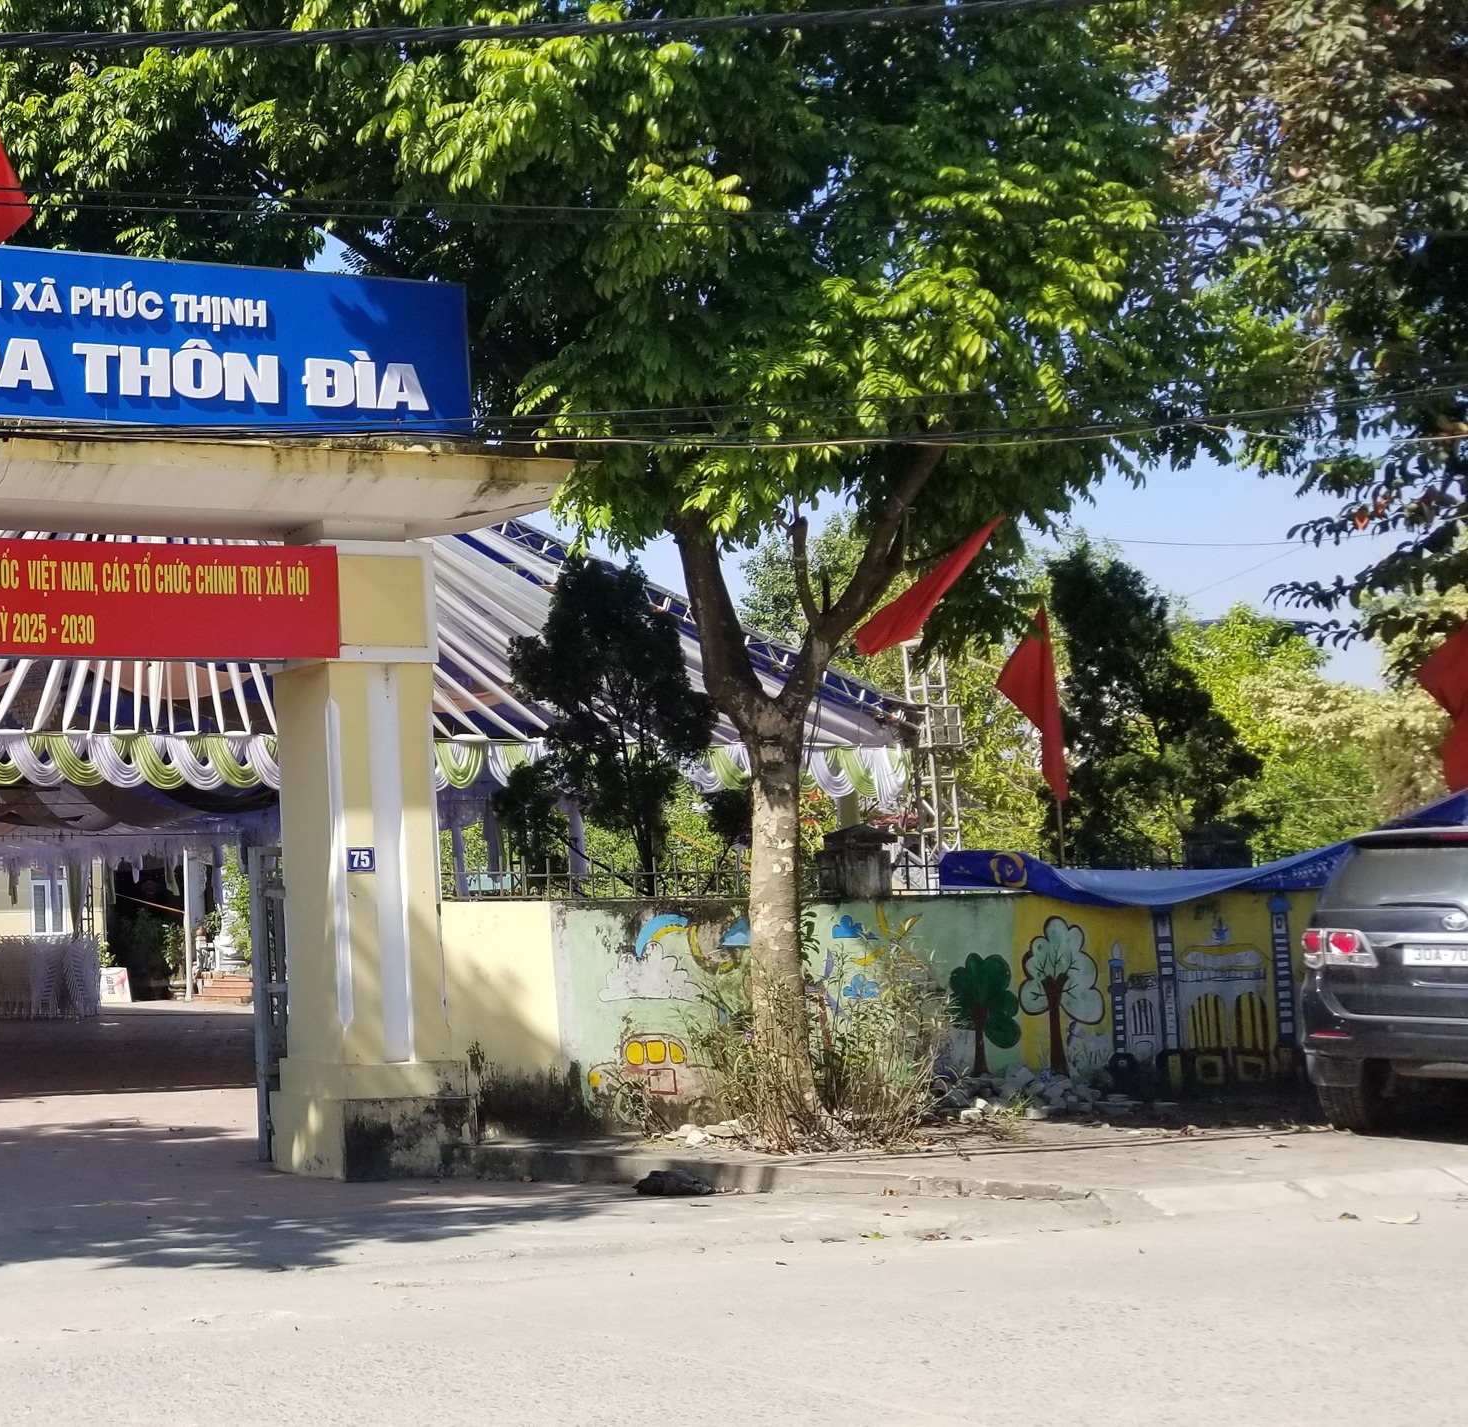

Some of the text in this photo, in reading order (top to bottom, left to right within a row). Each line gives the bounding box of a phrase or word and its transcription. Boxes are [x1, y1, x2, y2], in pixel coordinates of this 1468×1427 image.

[12, 277, 62, 314] XÃ
[71, 281, 163, 321] PHÚC
[170, 292, 267, 331] THỊNH
[72, 339, 279, 404] THÔN
[302, 350, 429, 411] ĐÌA
[27, 554, 57, 597] VIỆT
[61, 561, 98, 595] NAM,
[102, 556, 130, 593] CÁC
[134, 551, 151, 593] TỔ
[154, 558, 191, 594] CHỨC
[195, 559, 237, 595] CHÍNH
[240, 566, 262, 601] TRỊ
[265, 561, 284, 595] XÃ
[287, 560, 310, 601] HỘI
[13, 613, 47, 643] 2025
[61, 614, 95, 644] 2030
[350, 850, 370, 868] 75
